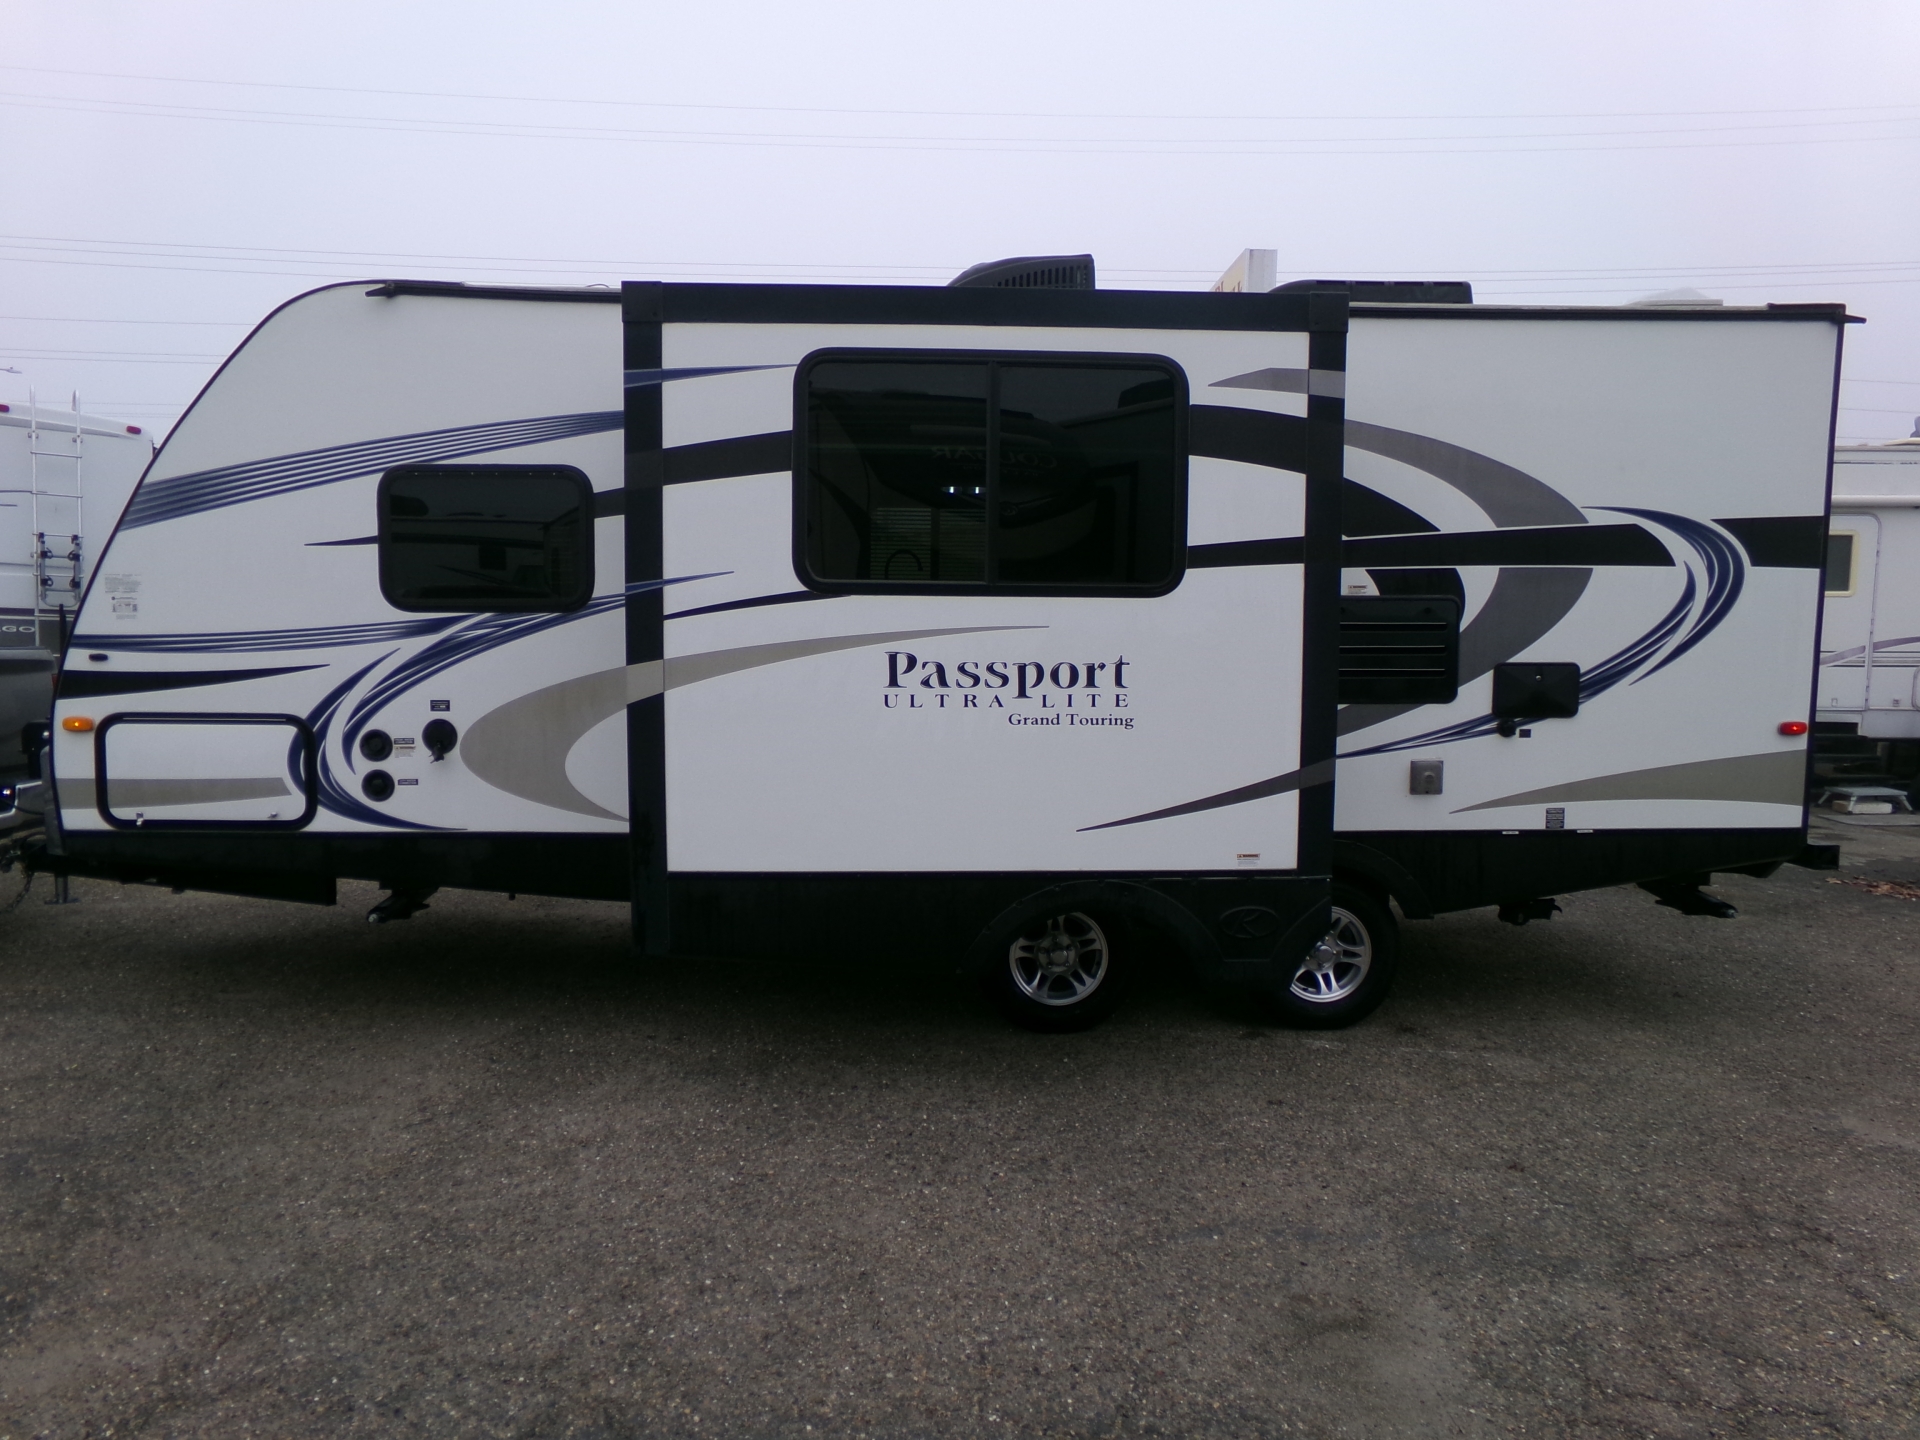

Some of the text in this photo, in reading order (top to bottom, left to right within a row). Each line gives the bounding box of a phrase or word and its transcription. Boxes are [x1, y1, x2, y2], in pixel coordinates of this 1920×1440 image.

[0, 625, 35, 633] GO
[883, 651, 1130, 699] Passport
[883, 693, 1129, 708] ULTRA LITE
[1008, 713, 1135, 730] Grand Touring
